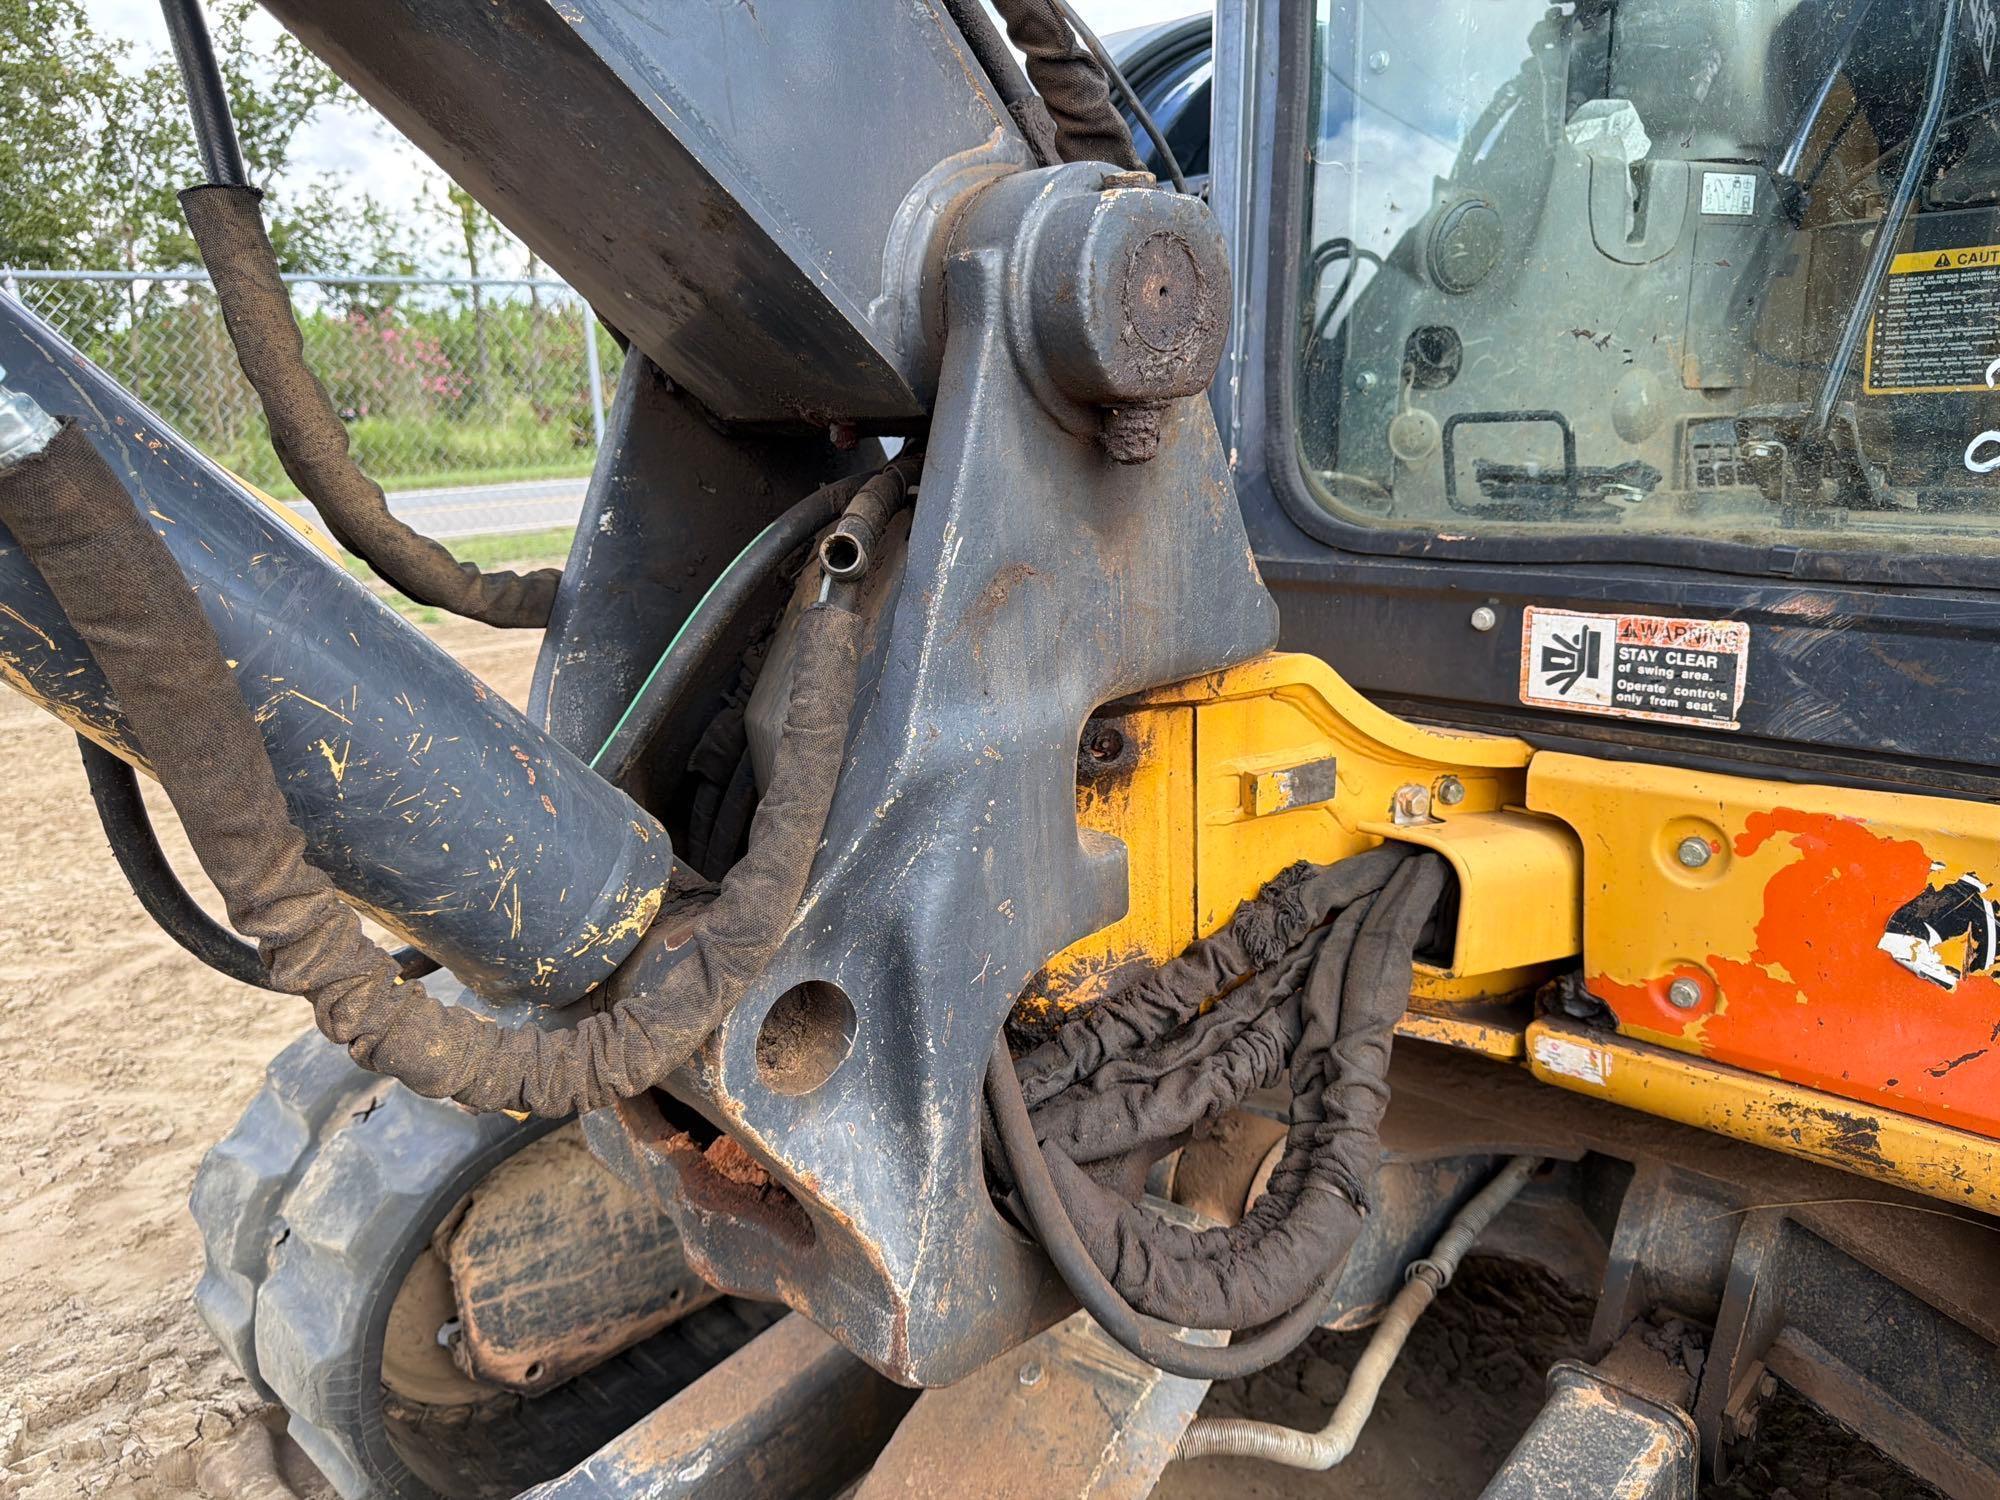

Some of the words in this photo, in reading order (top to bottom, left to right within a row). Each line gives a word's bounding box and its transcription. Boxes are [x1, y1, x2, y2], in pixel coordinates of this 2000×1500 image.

[1957, 250, 2000, 265] CAUT
[1641, 621, 1738, 647] WARNING
[1619, 647, 1659, 662] STAY
[1665, 652, 1718, 669] CLEAR
[1618, 663, 1631, 673] of
[1637, 666, 1674, 680] swing
[1681, 670, 1713, 681] area.
[1617, 679, 1666, 694] Operate
[1673, 687, 1728, 701] controls
[1616, 693, 1643, 705] only
[1649, 695, 1679, 708] from
[1686, 701, 1717, 712] seat.
